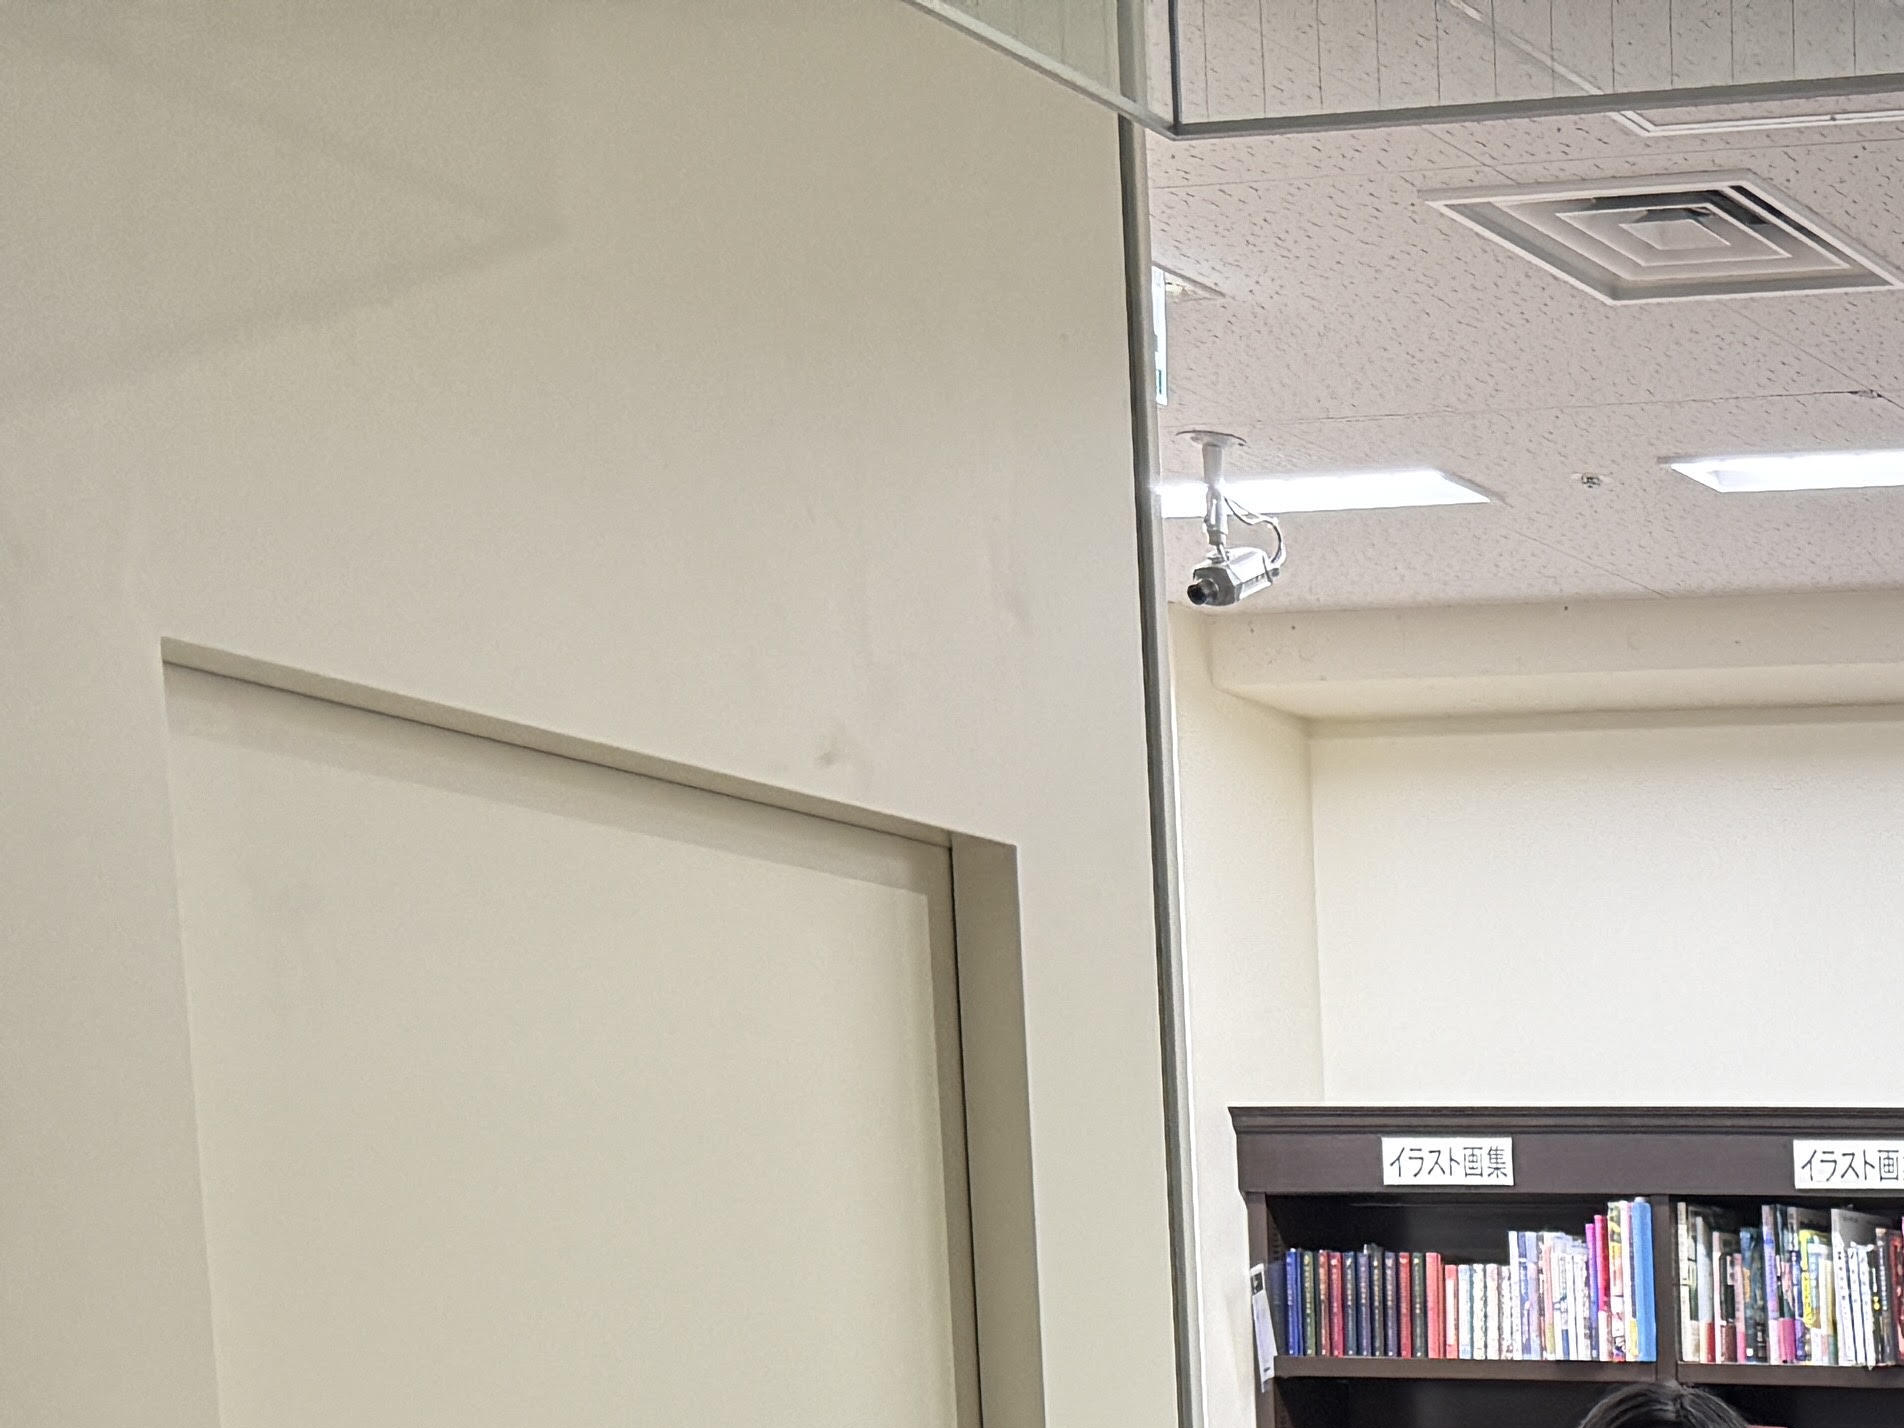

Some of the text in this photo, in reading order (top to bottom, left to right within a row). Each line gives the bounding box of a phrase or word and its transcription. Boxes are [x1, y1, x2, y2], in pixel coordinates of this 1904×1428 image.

[1388, 1146, 1509, 1179] イラスト画集
